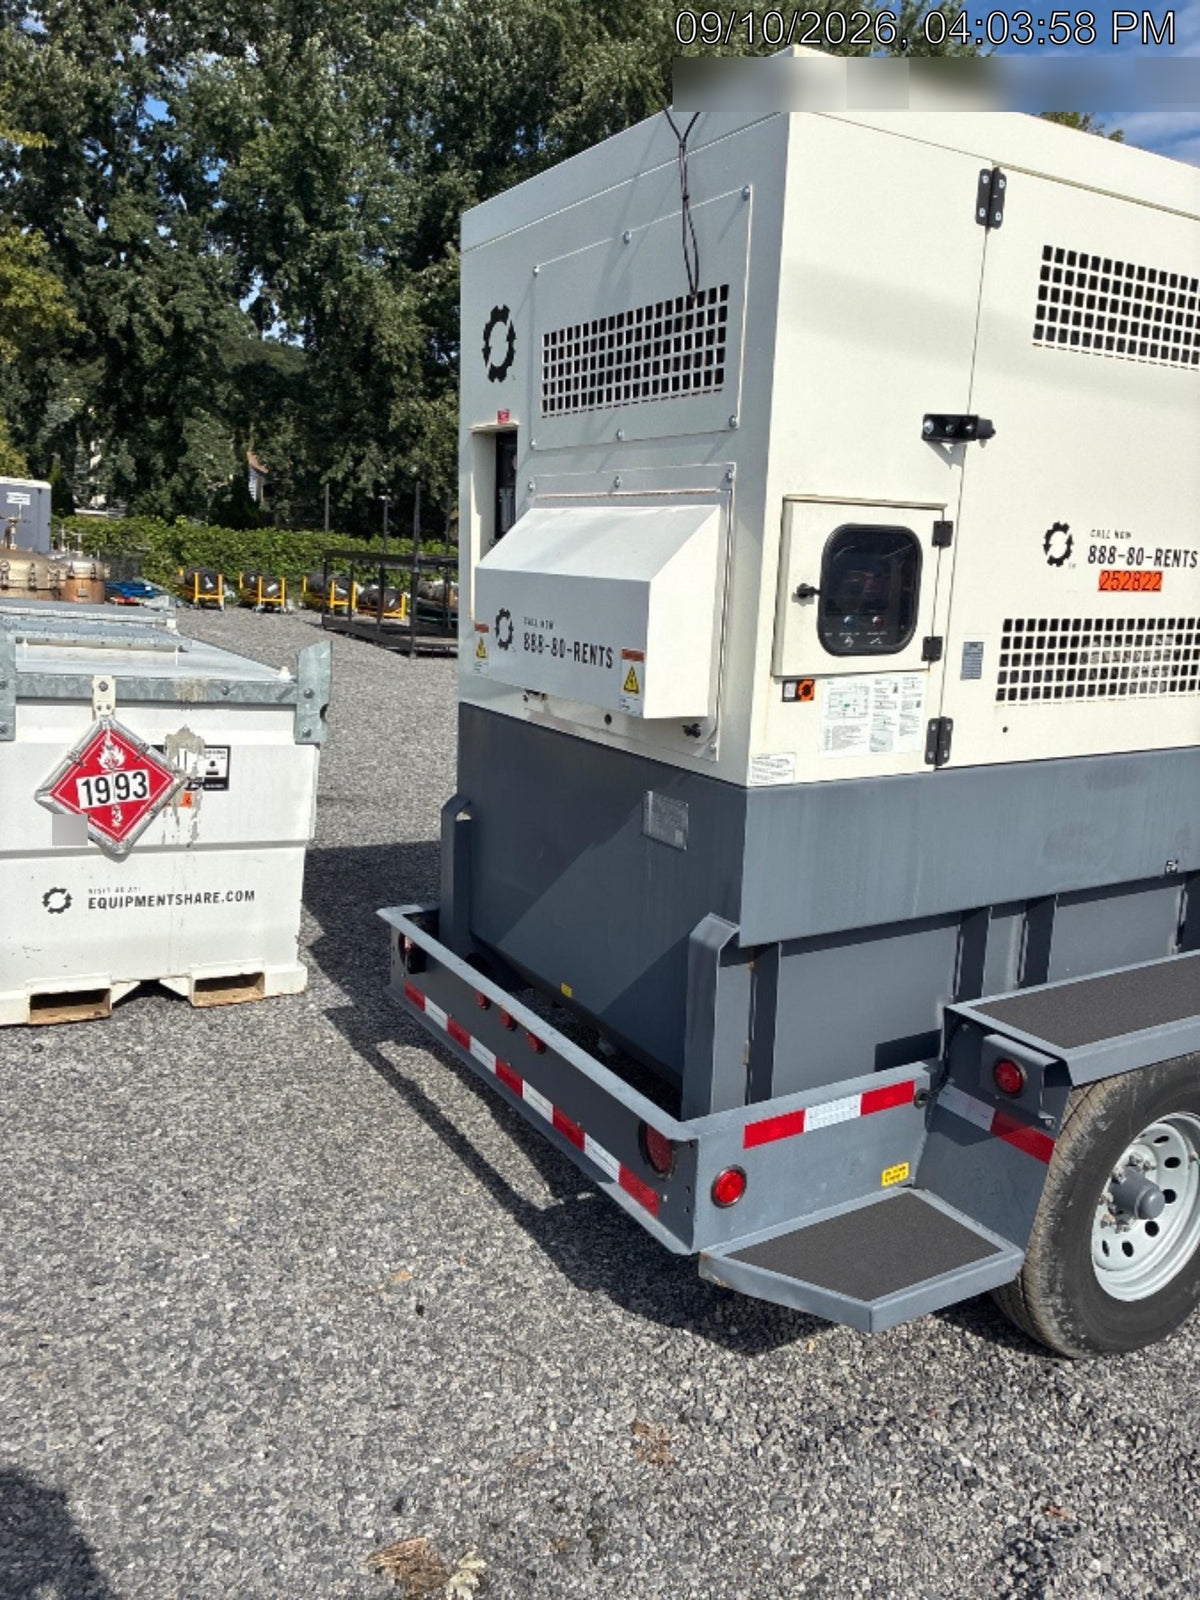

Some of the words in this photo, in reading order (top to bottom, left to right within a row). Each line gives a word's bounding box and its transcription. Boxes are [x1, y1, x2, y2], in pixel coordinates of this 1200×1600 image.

[1087, 544, 1198, 568] 888-80-RENTS
[1099, 570, 1162, 591] 252822
[523, 632, 613, 669] 888-80-RENTS
[81, 771, 148, 806] 1993
[88, 890, 255, 910] EQUIPMENTSHARE.COM
